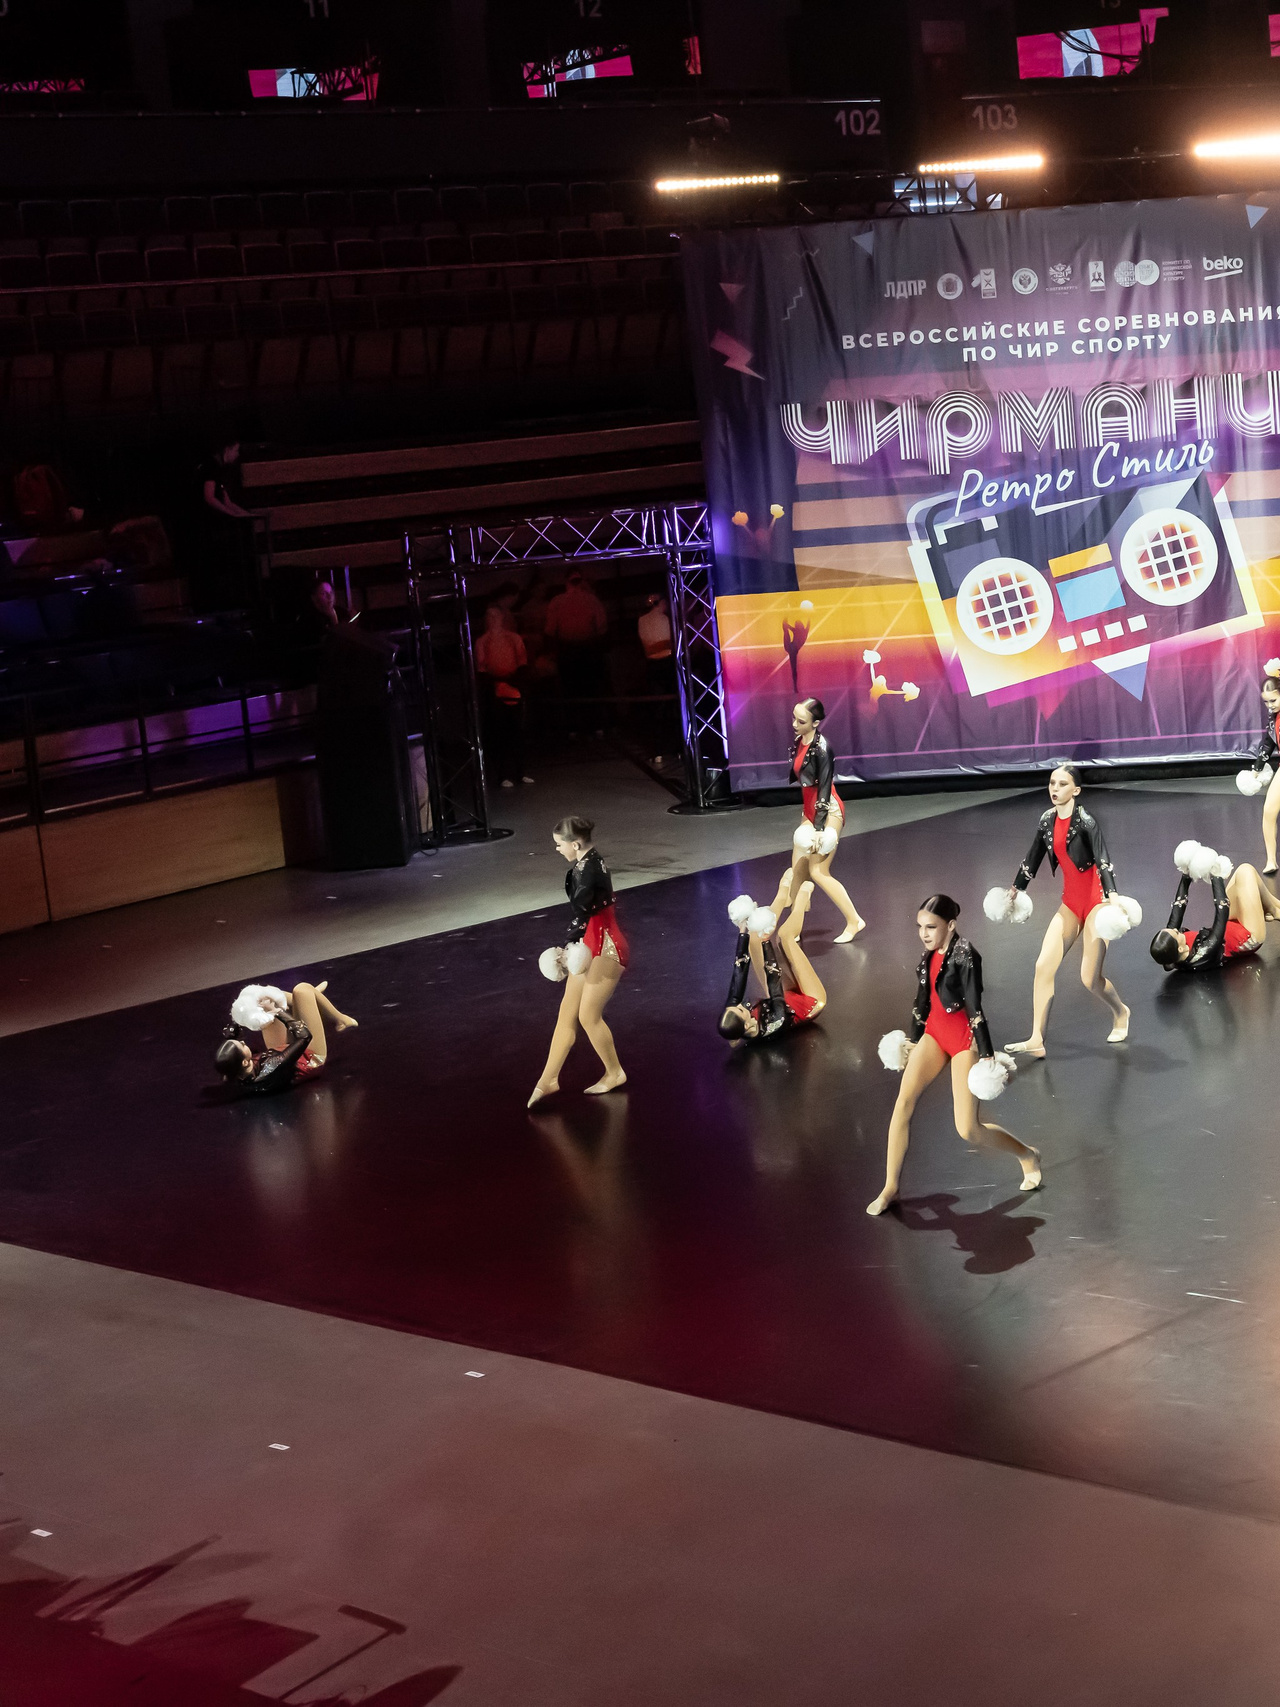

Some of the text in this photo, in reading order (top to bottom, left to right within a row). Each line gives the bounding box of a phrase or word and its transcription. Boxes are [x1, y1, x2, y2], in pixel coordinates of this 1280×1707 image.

[834, 109, 881, 136] 102
[972, 104, 1018, 131] 103
[1202, 256, 1244, 271] beko
[884, 279, 927, 300] ЛДПР
[842, 319, 1066, 350] ВСЕРОССИЙСКИЕ
[962, 333, 1174, 363] ПО ЧИР СПОРТУ
[954, 440, 1214, 517] Ретро Стиль
